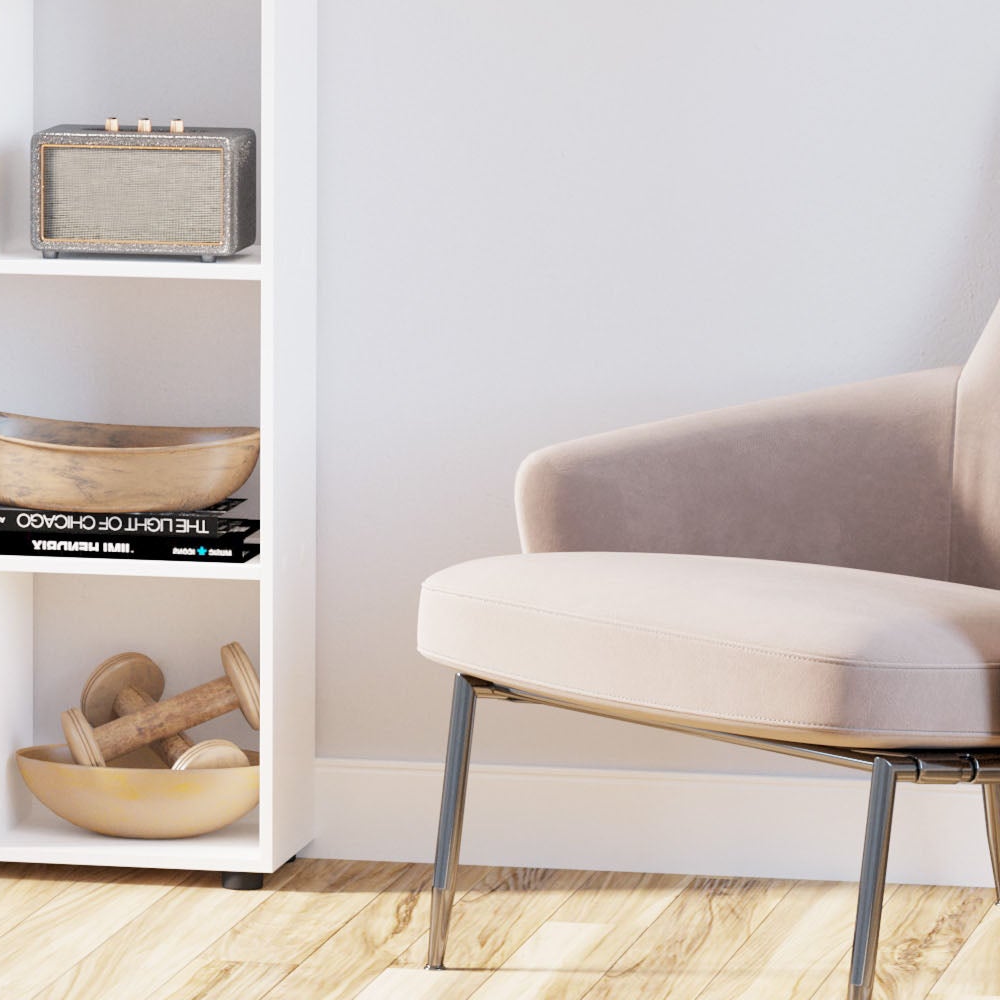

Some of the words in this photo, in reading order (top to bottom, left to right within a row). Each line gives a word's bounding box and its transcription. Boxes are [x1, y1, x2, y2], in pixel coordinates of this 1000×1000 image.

[16, 512, 96, 531] CHICAGO
[98, 516, 123, 531] OF
[124, 517, 173, 533] LIGHT
[175, 518, 210, 534] THE
